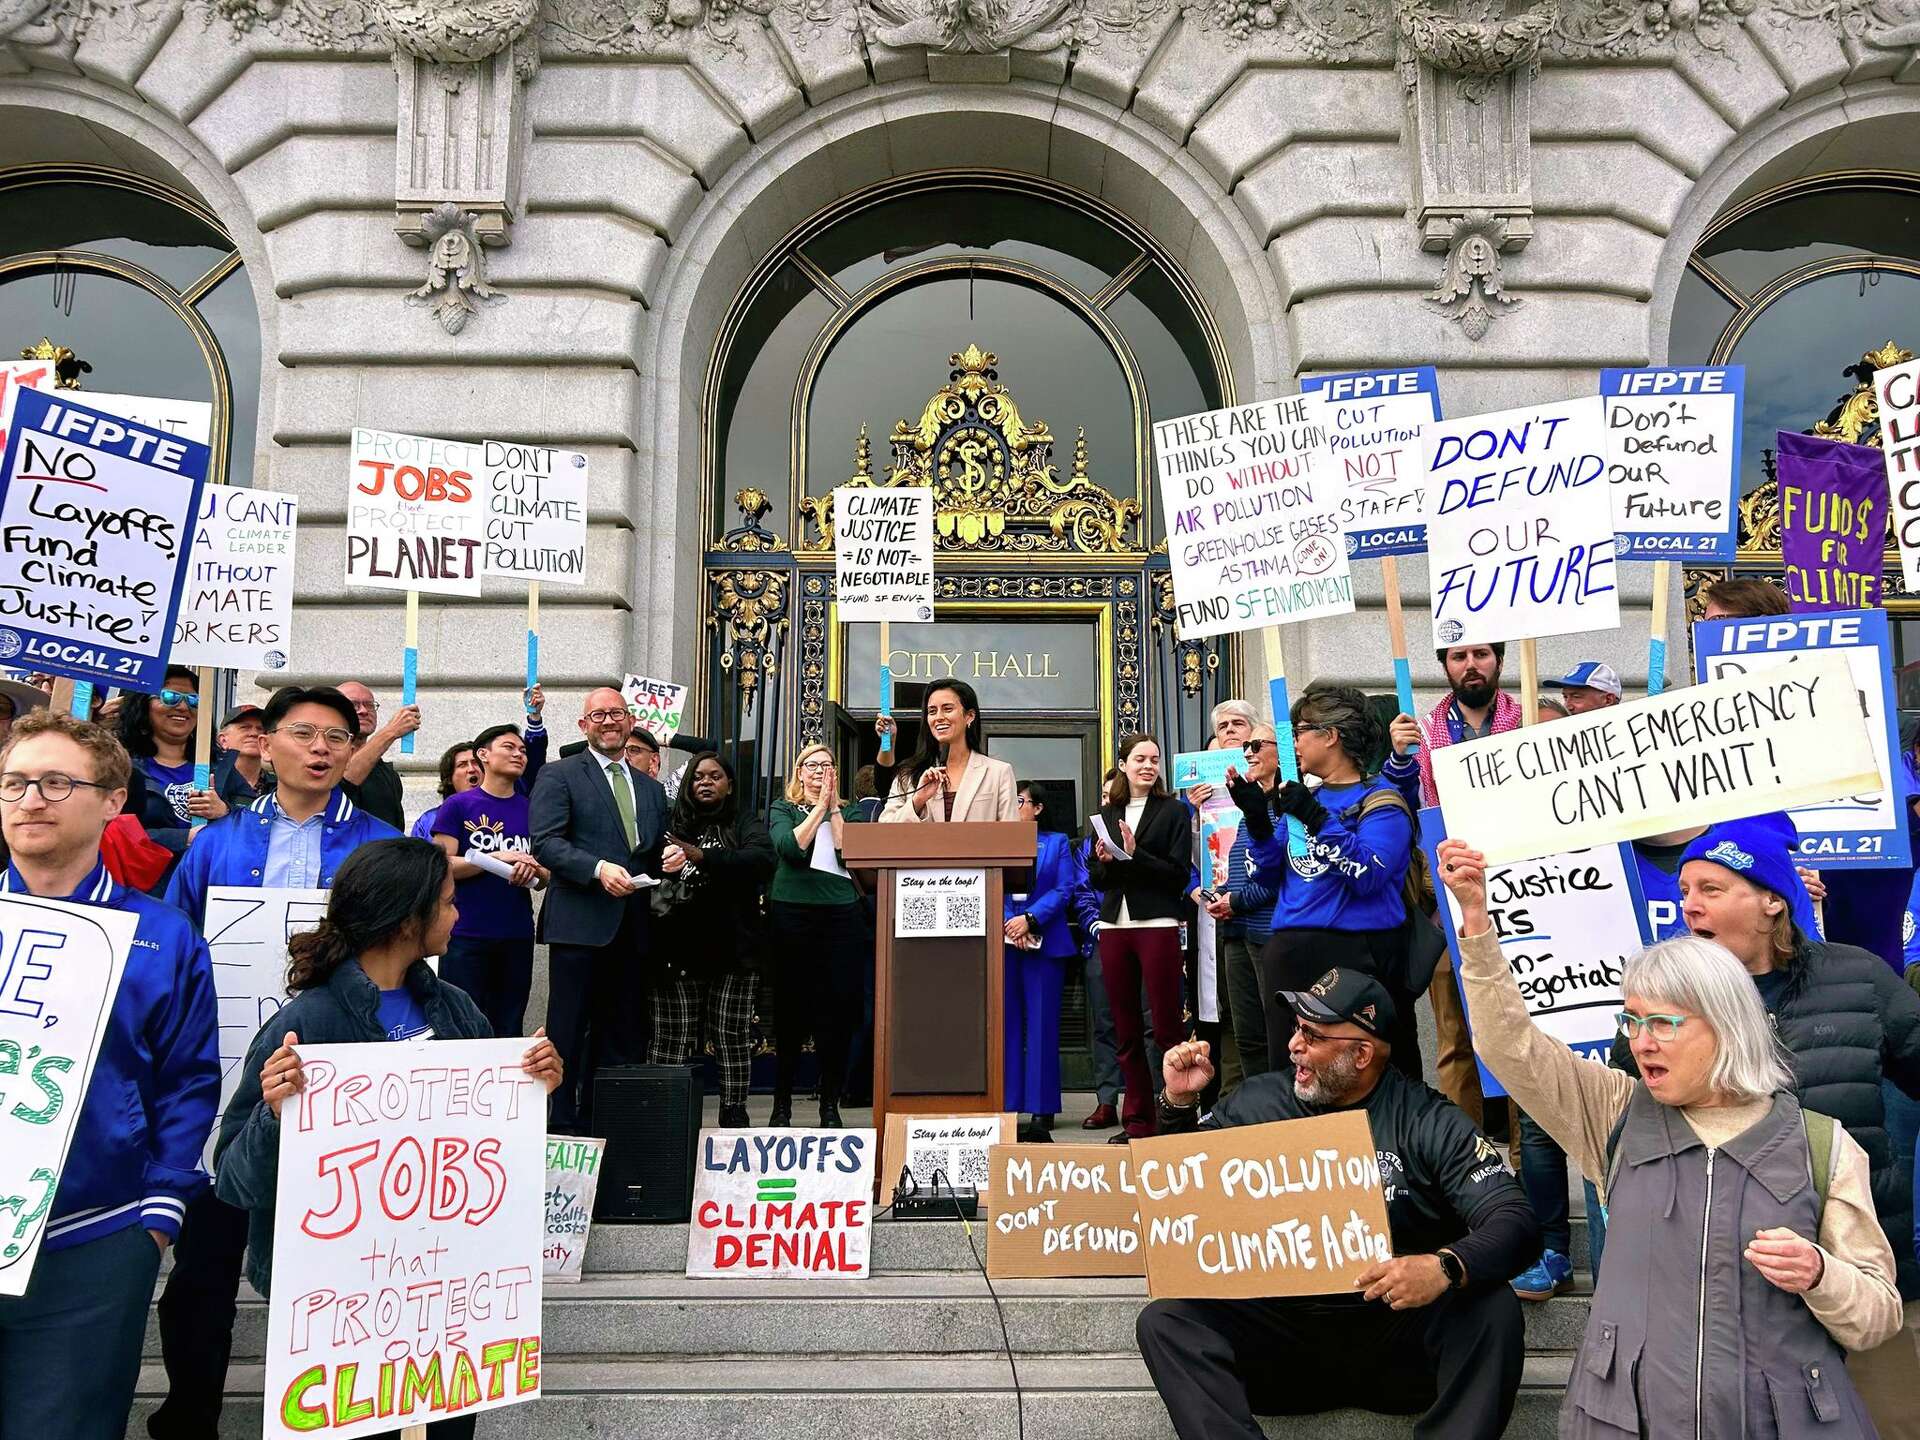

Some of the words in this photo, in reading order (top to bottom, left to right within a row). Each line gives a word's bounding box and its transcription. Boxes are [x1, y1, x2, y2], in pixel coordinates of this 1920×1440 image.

[1324, 373, 1419, 401] IFPTE
[1618, 371, 1726, 394] IFPTE
[1157, 420, 1223, 449] THESE
[1229, 406, 1266, 436] ARE
[1275, 398, 1309, 427] THE
[1337, 404, 1385, 430] CUT
[1610, 402, 1697, 431] Don't
[40, 404, 188, 470] IFPTE
[356, 430, 480, 468] PROTECT
[1161, 442, 1235, 476] THINGS
[1242, 431, 1286, 458] YOU
[1292, 425, 1327, 450] CAN
[1330, 424, 1422, 454] POLLUTION
[1430, 416, 1570, 472] DON'T
[1624, 434, 1718, 455] Defund
[22, 439, 96, 481] NO
[485, 442, 559, 473] DON'T
[1344, 450, 1403, 482] NOT
[357, 460, 473, 503] JOBS
[492, 471, 548, 501] CUT
[1187, 477, 1214, 499] DO
[1227, 452, 1313, 490] WITHOUT
[1438, 455, 1604, 515] DEFUND
[352, 505, 473, 530] PROTECT
[491, 495, 581, 522] CLIMATE
[847, 496, 922, 516] CLIMATE
[1175, 506, 1211, 536] AIR
[1214, 482, 1314, 526] POLLUTION
[1625, 493, 1722, 520] Future
[4, 526, 97, 567] Fund
[226, 527, 292, 540] CLIMATE
[487, 519, 534, 541] CUT
[841, 520, 917, 543] JUSTICE
[1184, 525, 1283, 567] GREENHOUSE
[1290, 513, 1339, 540] GASES
[1361, 530, 1417, 548] LOCAL
[1468, 518, 1560, 556] OUR
[1633, 536, 1695, 550] LOCAL
[1697, 536, 1718, 550] 21
[229, 542, 286, 554] LEADER
[347, 536, 482, 580] PLANET
[484, 542, 584, 574] POLLUTION
[856, 549, 873, 566] IS
[877, 549, 907, 567] NOT
[22, 560, 155, 606] Climate
[197, 562, 278, 583] ITHOUT
[840, 572, 930, 588] NEGOTIABLE
[1219, 555, 1292, 585] ASTHMA
[1435, 540, 1615, 619] FUTURE
[194, 588, 273, 612] MATE
[1178, 596, 1230, 629] FUND
[1722, 618, 1861, 653] IFPTE
[25, 637, 110, 670] LOCAL
[114, 657, 143, 676] 21
[888, 651, 962, 678] CITY
[973, 651, 1060, 678] HALL
[629, 677, 681, 697] MEET
[635, 692, 673, 710] CAP
[1461, 750, 1513, 790] THE
[1515, 720, 1627, 780] CLIMATE
[1629, 675, 1821, 757] EMERGENCY
[1551, 762, 1649, 827] CAN'T
[1797, 837, 1850, 854] CAL
[1857, 836, 1882, 853] 21
[901, 877, 924, 888] Stay
[927, 878, 936, 886] in
[939, 875, 953, 886] the
[955, 875, 979, 888] loop!
[1489, 866, 1613, 904] Justice
[299, 1060, 534, 1133] PROTECT
[912, 1128, 936, 1141] Stay
[939, 1129, 949, 1138] in
[951, 1127, 965, 1137] the
[968, 1126, 993, 1139] loop!
[545, 1142, 598, 1175] EALTH
[705, 1135, 865, 1175] LAYOFFS
[301, 1136, 507, 1240] JOBS
[1006, 1157, 1111, 1196] MAYOR
[1137, 1152, 1209, 1200] CUT
[1220, 1149, 1380, 1198] POLLUTION
[545, 1206, 588, 1222] health
[547, 1223, 586, 1234] costs
[698, 1200, 866, 1230] CLIMATE
[995, 1199, 1058, 1235] DON'T
[1149, 1214, 1198, 1246] NOT
[714, 1231, 863, 1272] DENIAL
[1043, 1222, 1139, 1255] DEFUND
[1197, 1218, 1317, 1275] CLIMATE
[360, 1236, 449, 1281] that
[290, 1266, 532, 1356] PROTECT
[384, 1329, 469, 1362] OUR
[280, 1335, 540, 1432] CLIMATE
